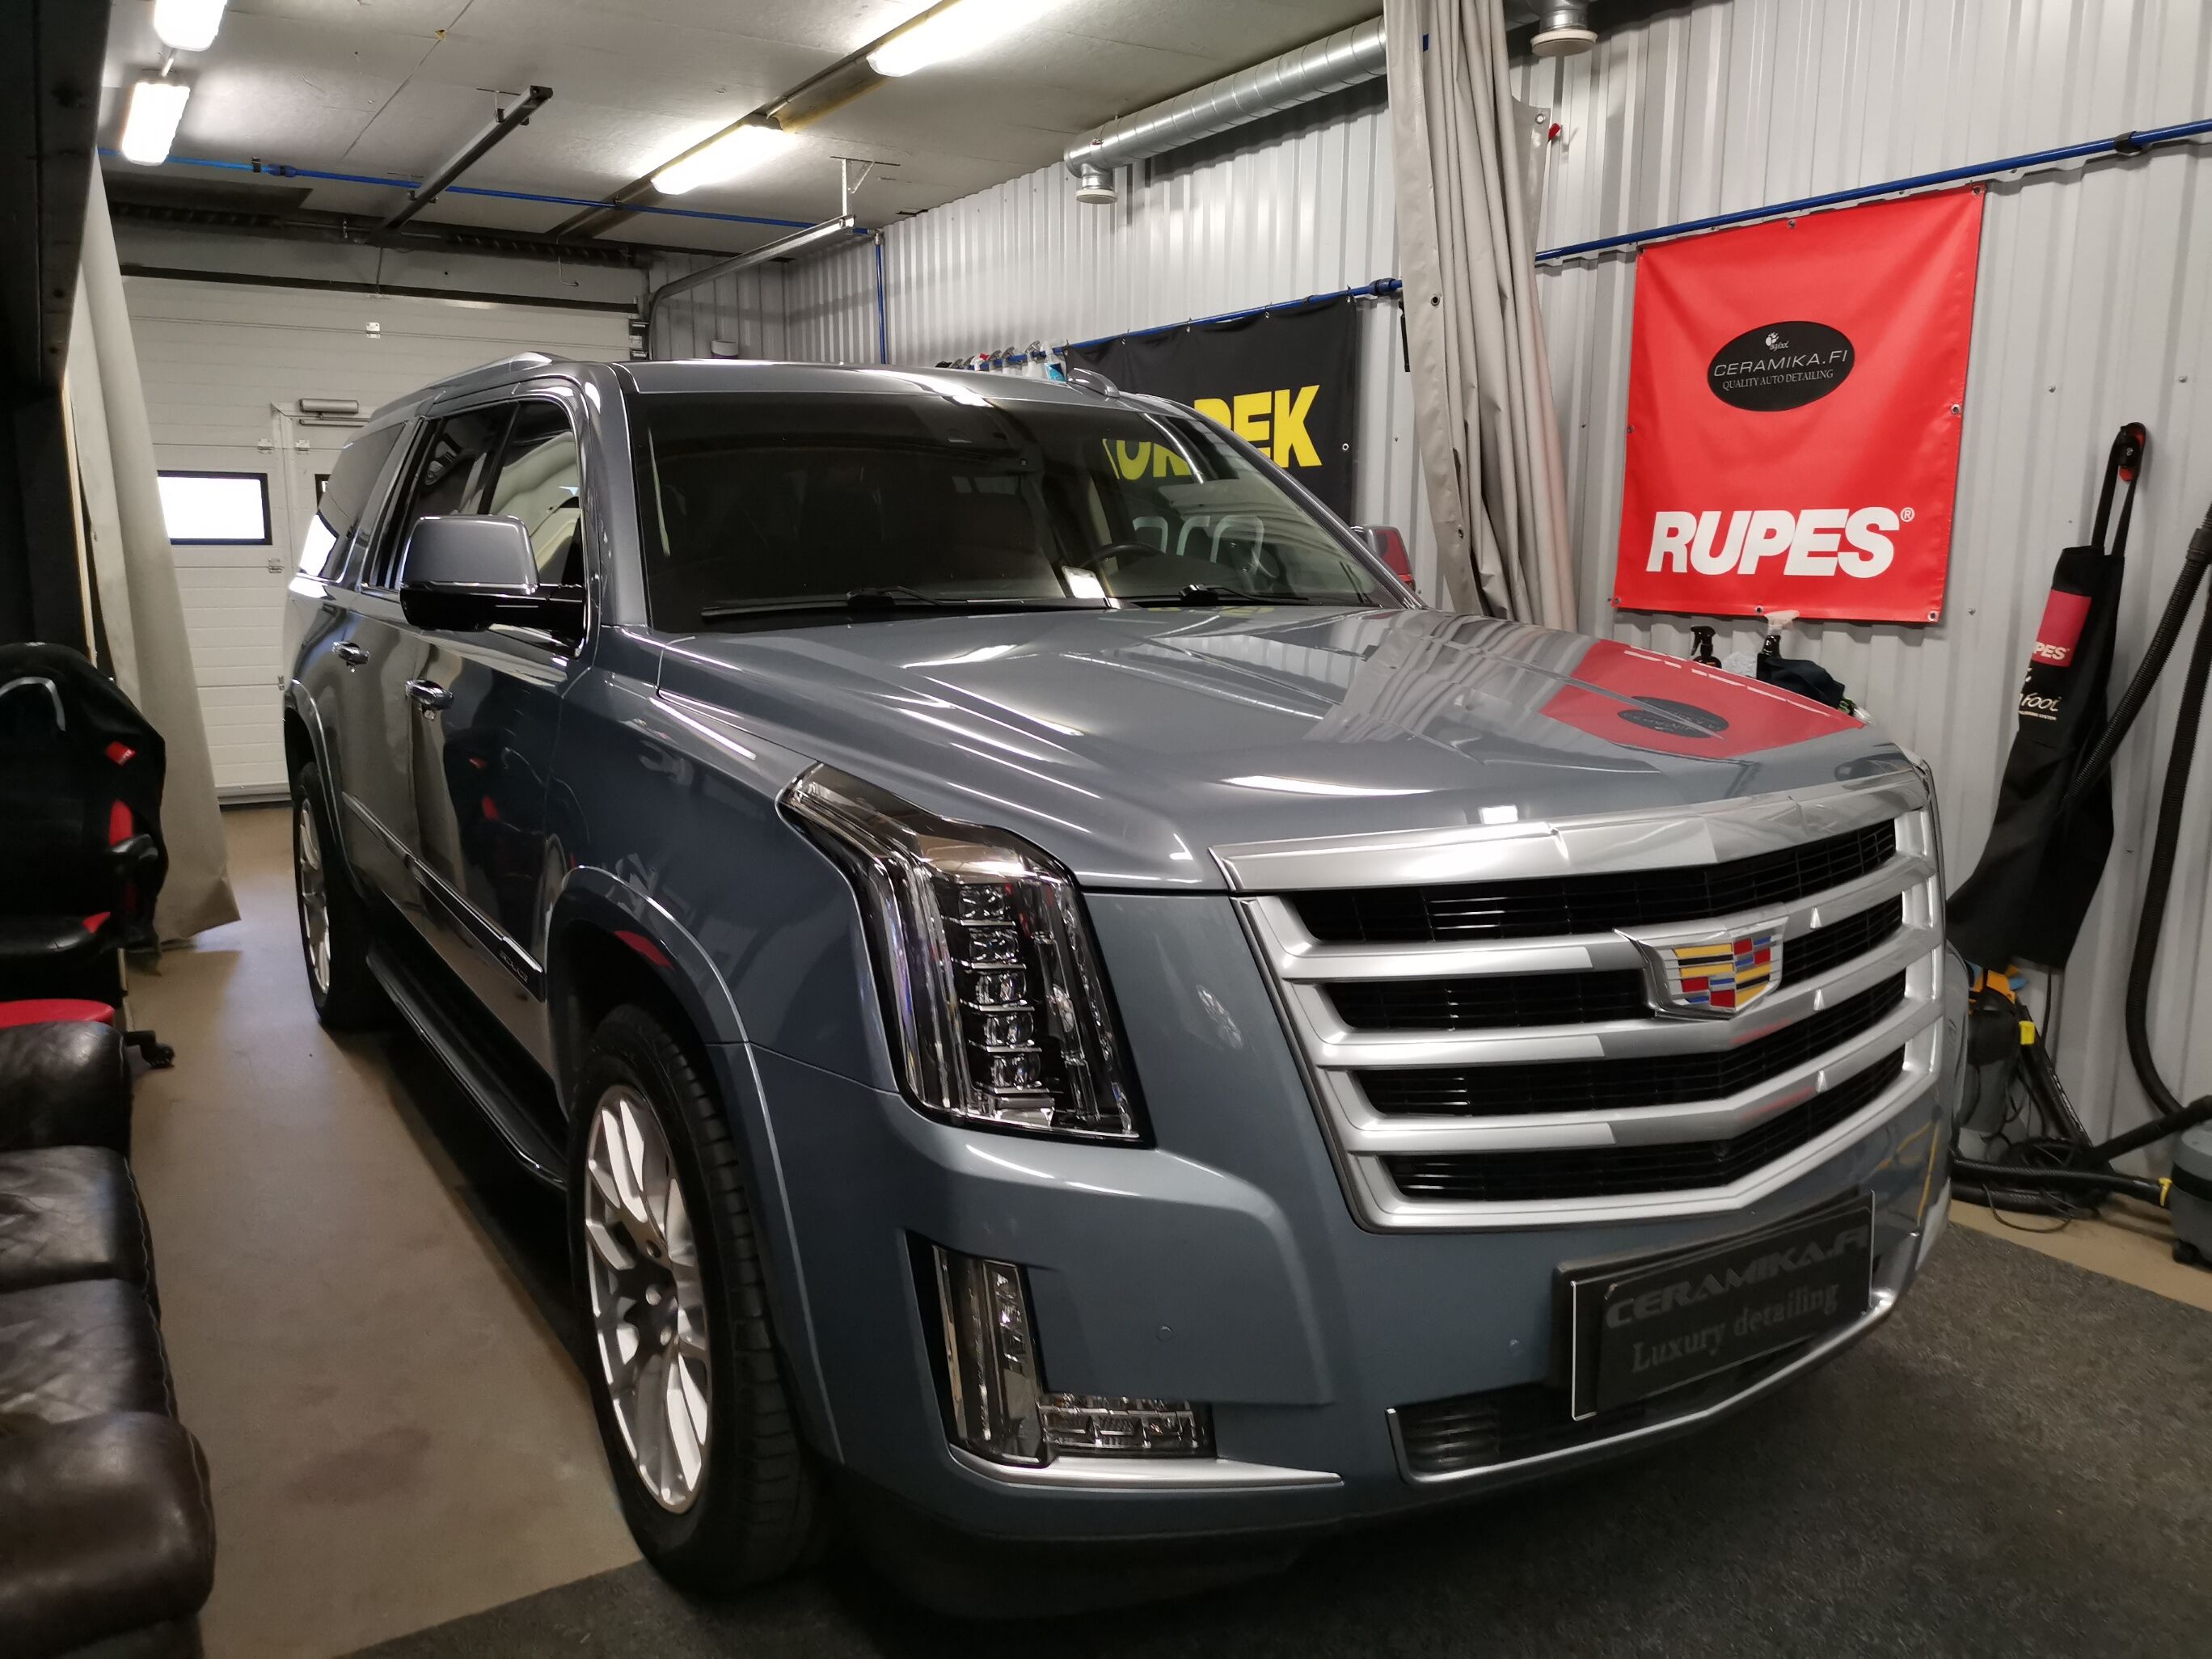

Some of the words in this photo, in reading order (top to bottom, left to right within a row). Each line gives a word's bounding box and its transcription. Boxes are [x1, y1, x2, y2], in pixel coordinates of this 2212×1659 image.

[1713, 349, 1848, 378] CERAMIKA.FI
[1722, 377, 1759, 391] QUALITY
[1760, 374, 1784, 386] AUTO
[1785, 369, 1834, 382] DETAILING
[1632, 1321, 1726, 1373] Luxury
[1733, 1283, 1839, 1339] detailing
